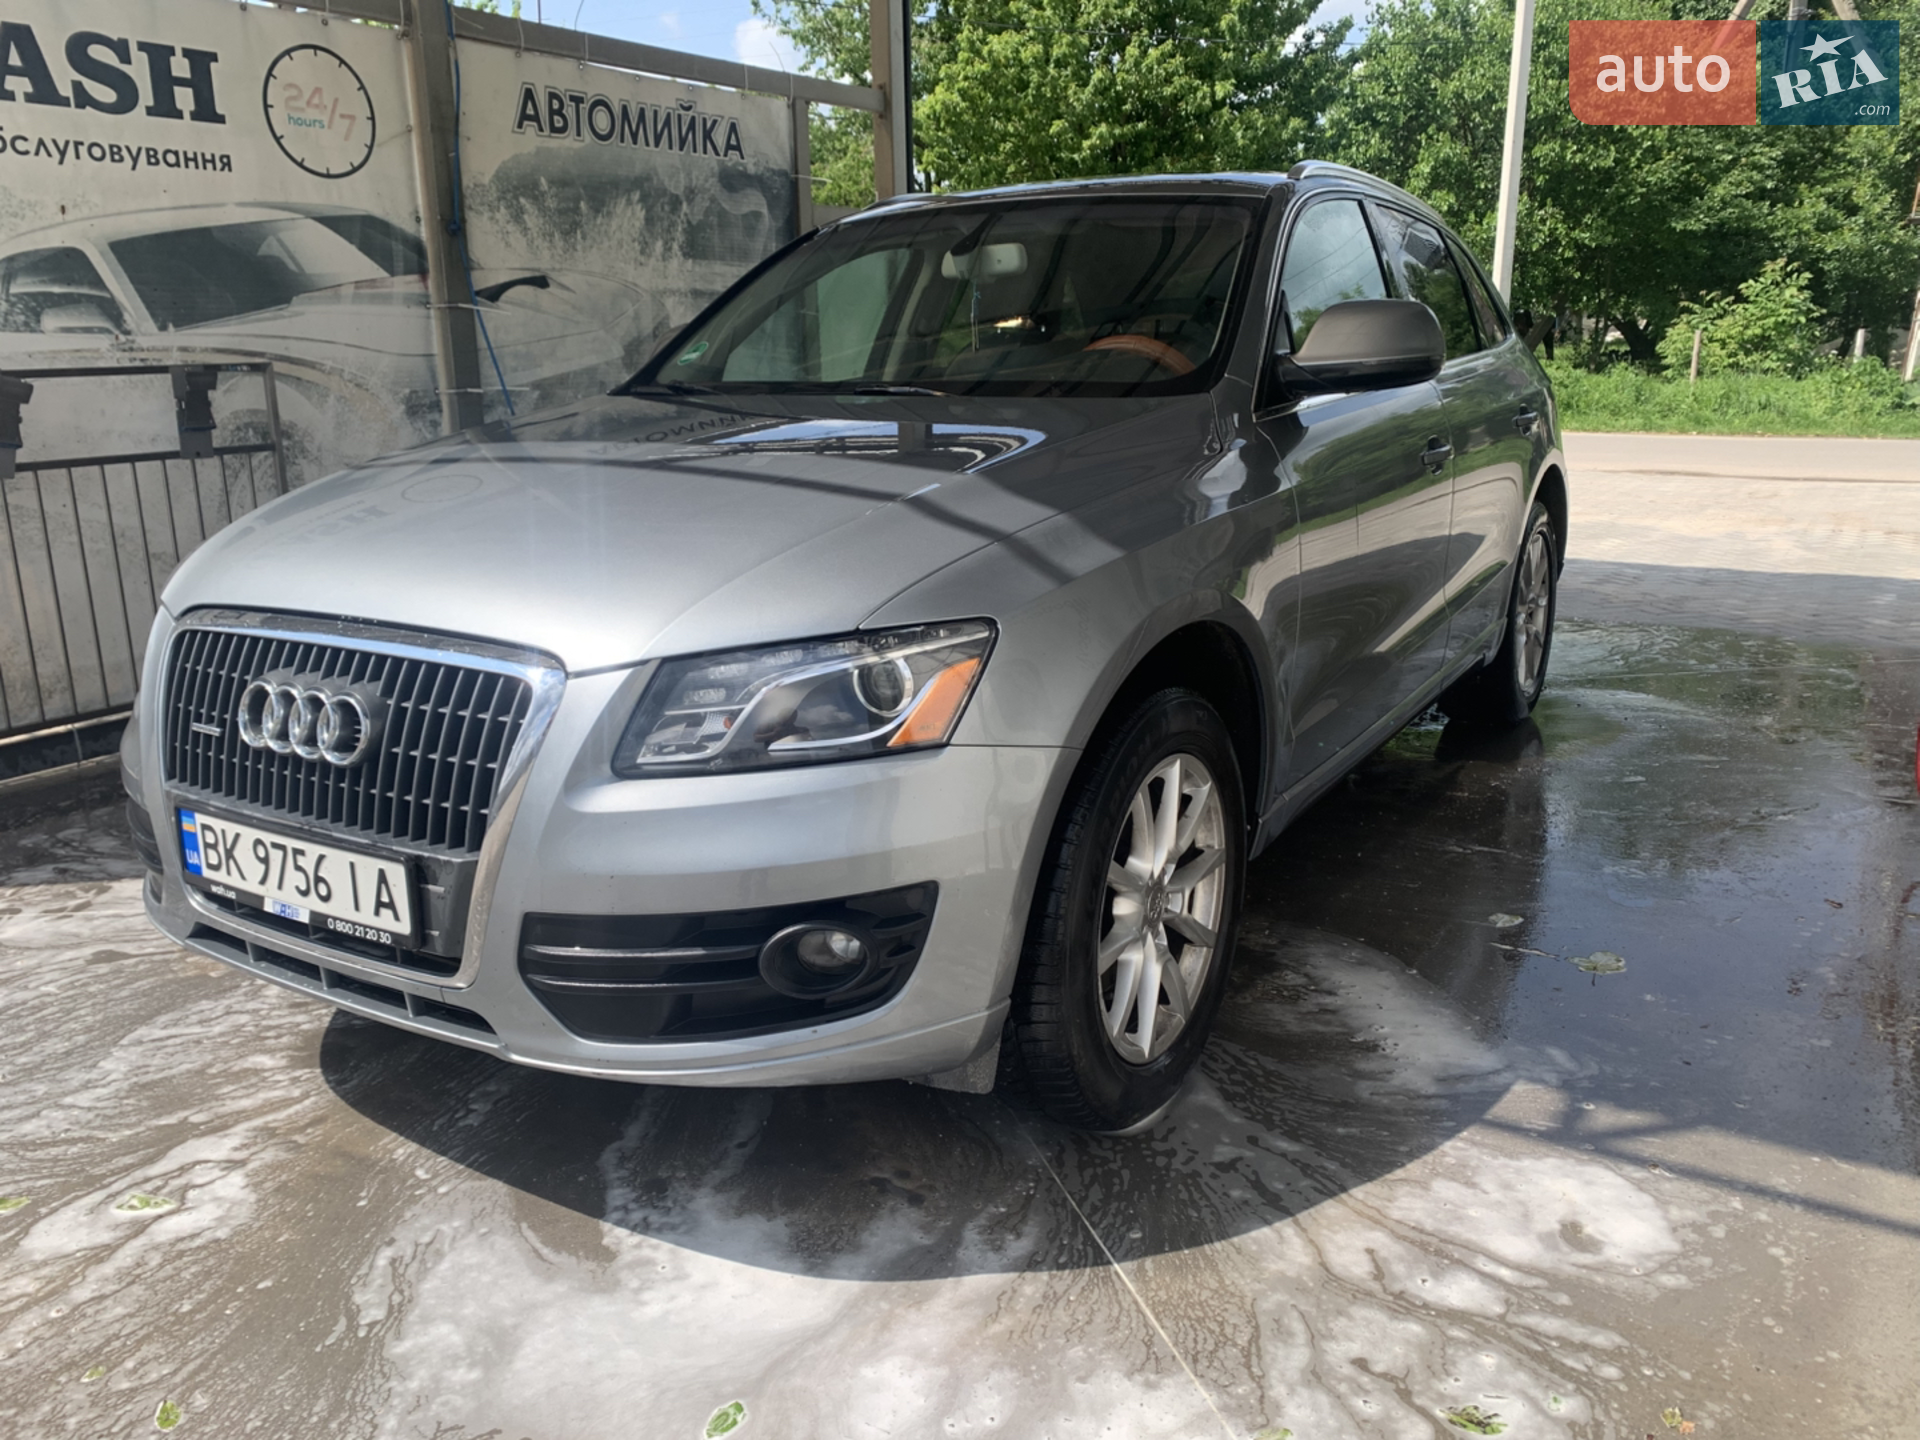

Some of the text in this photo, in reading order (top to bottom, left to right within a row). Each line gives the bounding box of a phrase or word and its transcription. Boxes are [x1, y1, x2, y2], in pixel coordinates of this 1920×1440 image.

[0, 20, 226, 125] ASH
[282, 82, 357, 142] 24/7
[287, 113, 326, 130] hours
[514, 83, 747, 160] АВТОМИЙКА
[186, 849, 201, 866] UA
[201, 823, 247, 882] BK
[251, 837, 332, 903] 9756
[327, 917, 392, 945] 0 800 21 20 30
